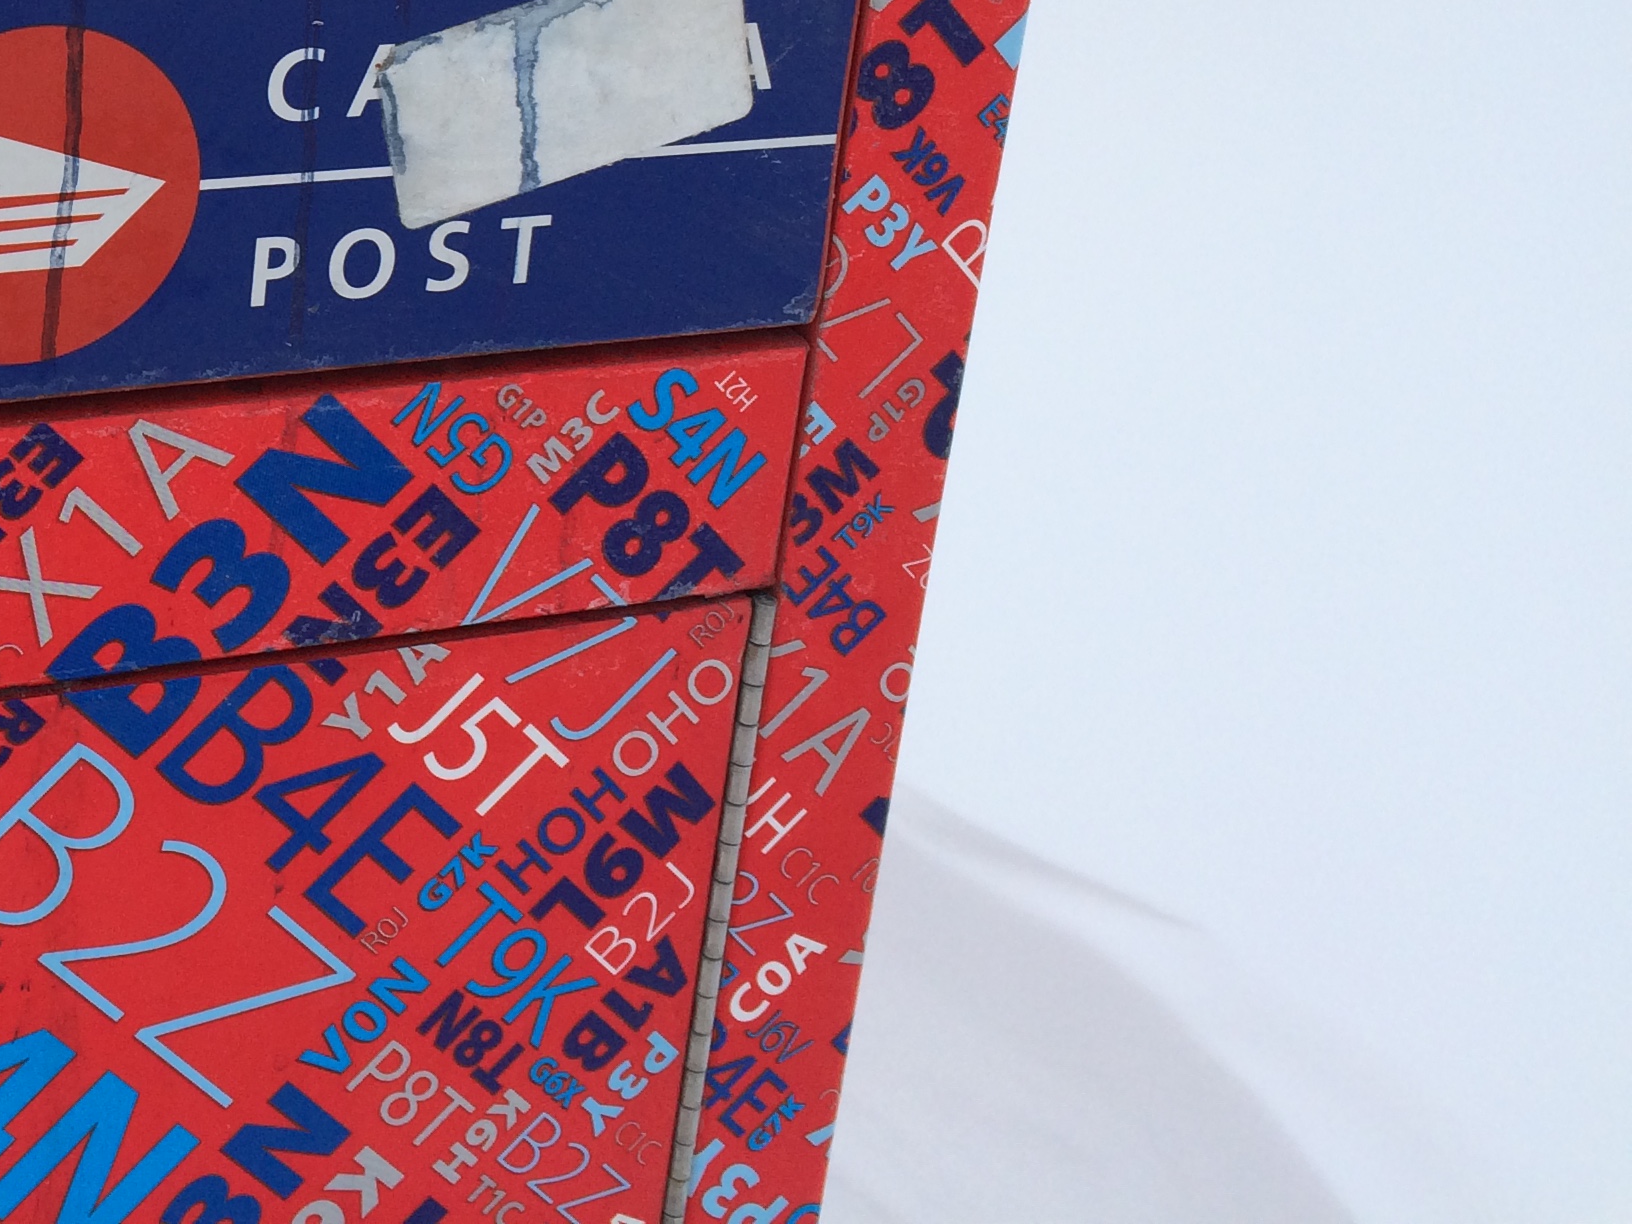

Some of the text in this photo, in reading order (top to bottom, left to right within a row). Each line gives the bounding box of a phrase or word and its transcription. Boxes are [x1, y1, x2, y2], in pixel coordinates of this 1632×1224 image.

[249, 215, 552, 308] POST
[841, 173, 939, 272] P3Y
[497, 384, 548, 430] G1P
[525, 389, 621, 485] M3C
[626, 368, 768, 509] S4N
[548, 431, 746, 623] P8T
[830, 488, 896, 550] T9K
[44, 393, 415, 757] B3N
[320, 629, 452, 740] Y1A
[155, 651, 463, 939] B4E
[387, 673, 570, 817] J5T
[418, 831, 499, 912] G7K
[584, 862, 696, 976] B2J
[435, 881, 599, 1049] T9K
[345, 1039, 476, 1147] P8T
[746, 1093, 806, 1152] G7K
